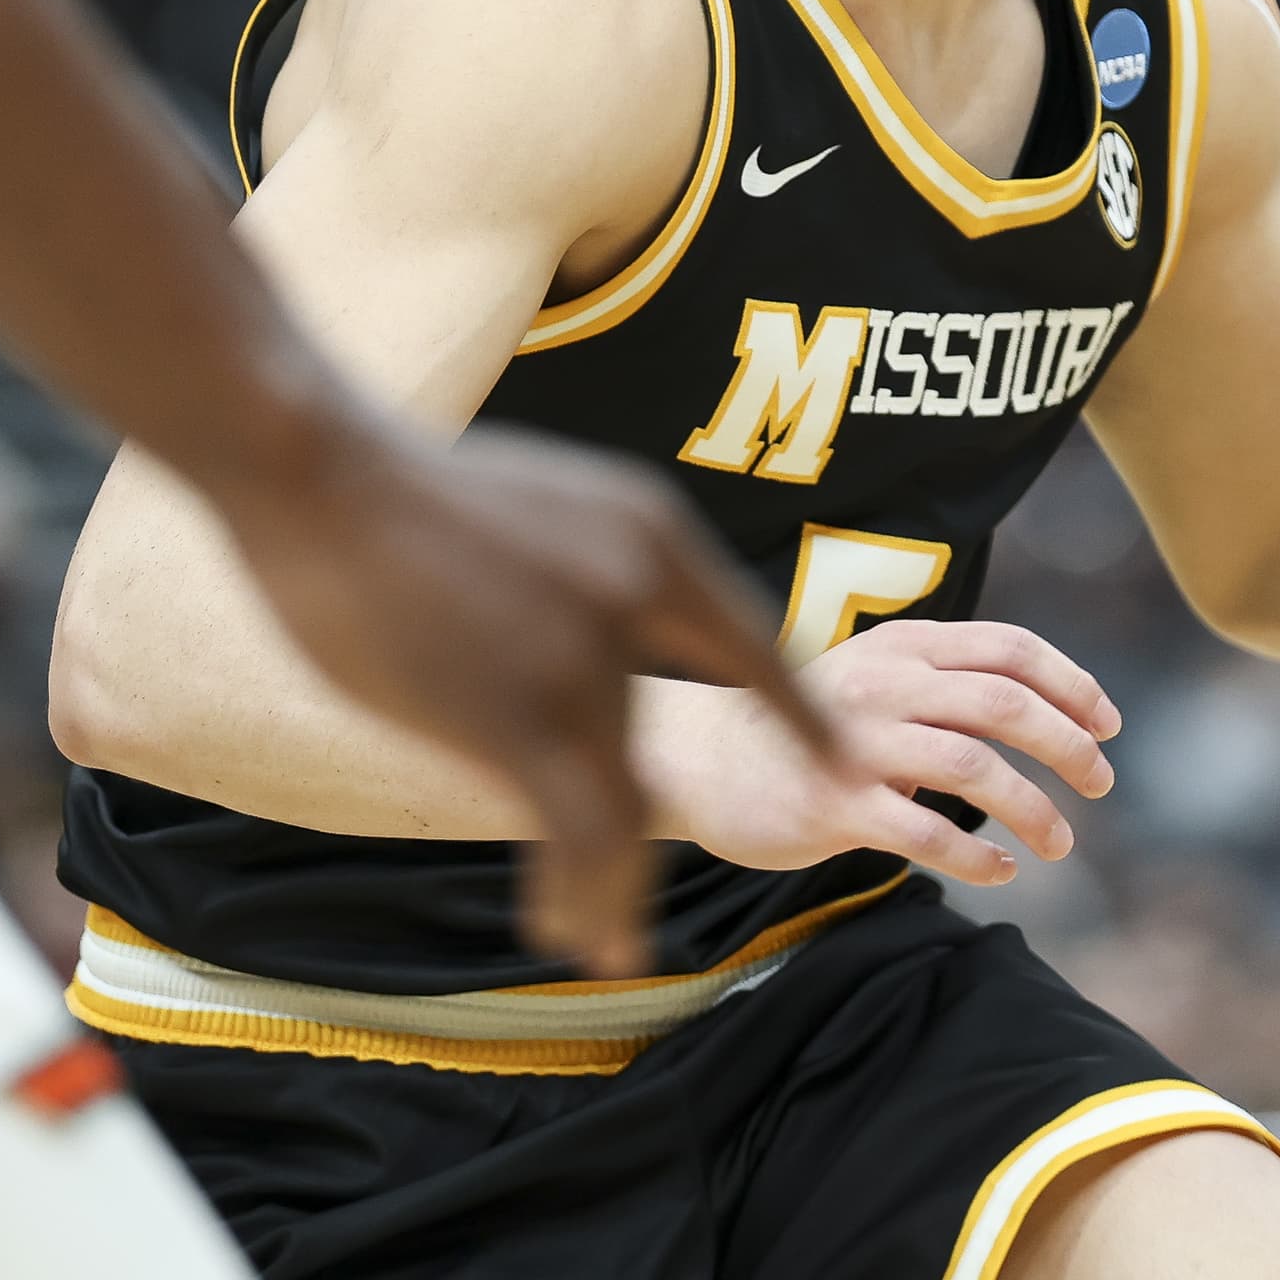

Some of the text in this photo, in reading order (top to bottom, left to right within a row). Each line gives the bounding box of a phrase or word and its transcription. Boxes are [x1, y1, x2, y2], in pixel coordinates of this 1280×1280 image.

[1098, 52, 1146, 86] NCAA
[1098, 131, 1139, 239] SEC
[676, 297, 1134, 486] MISSOURI
